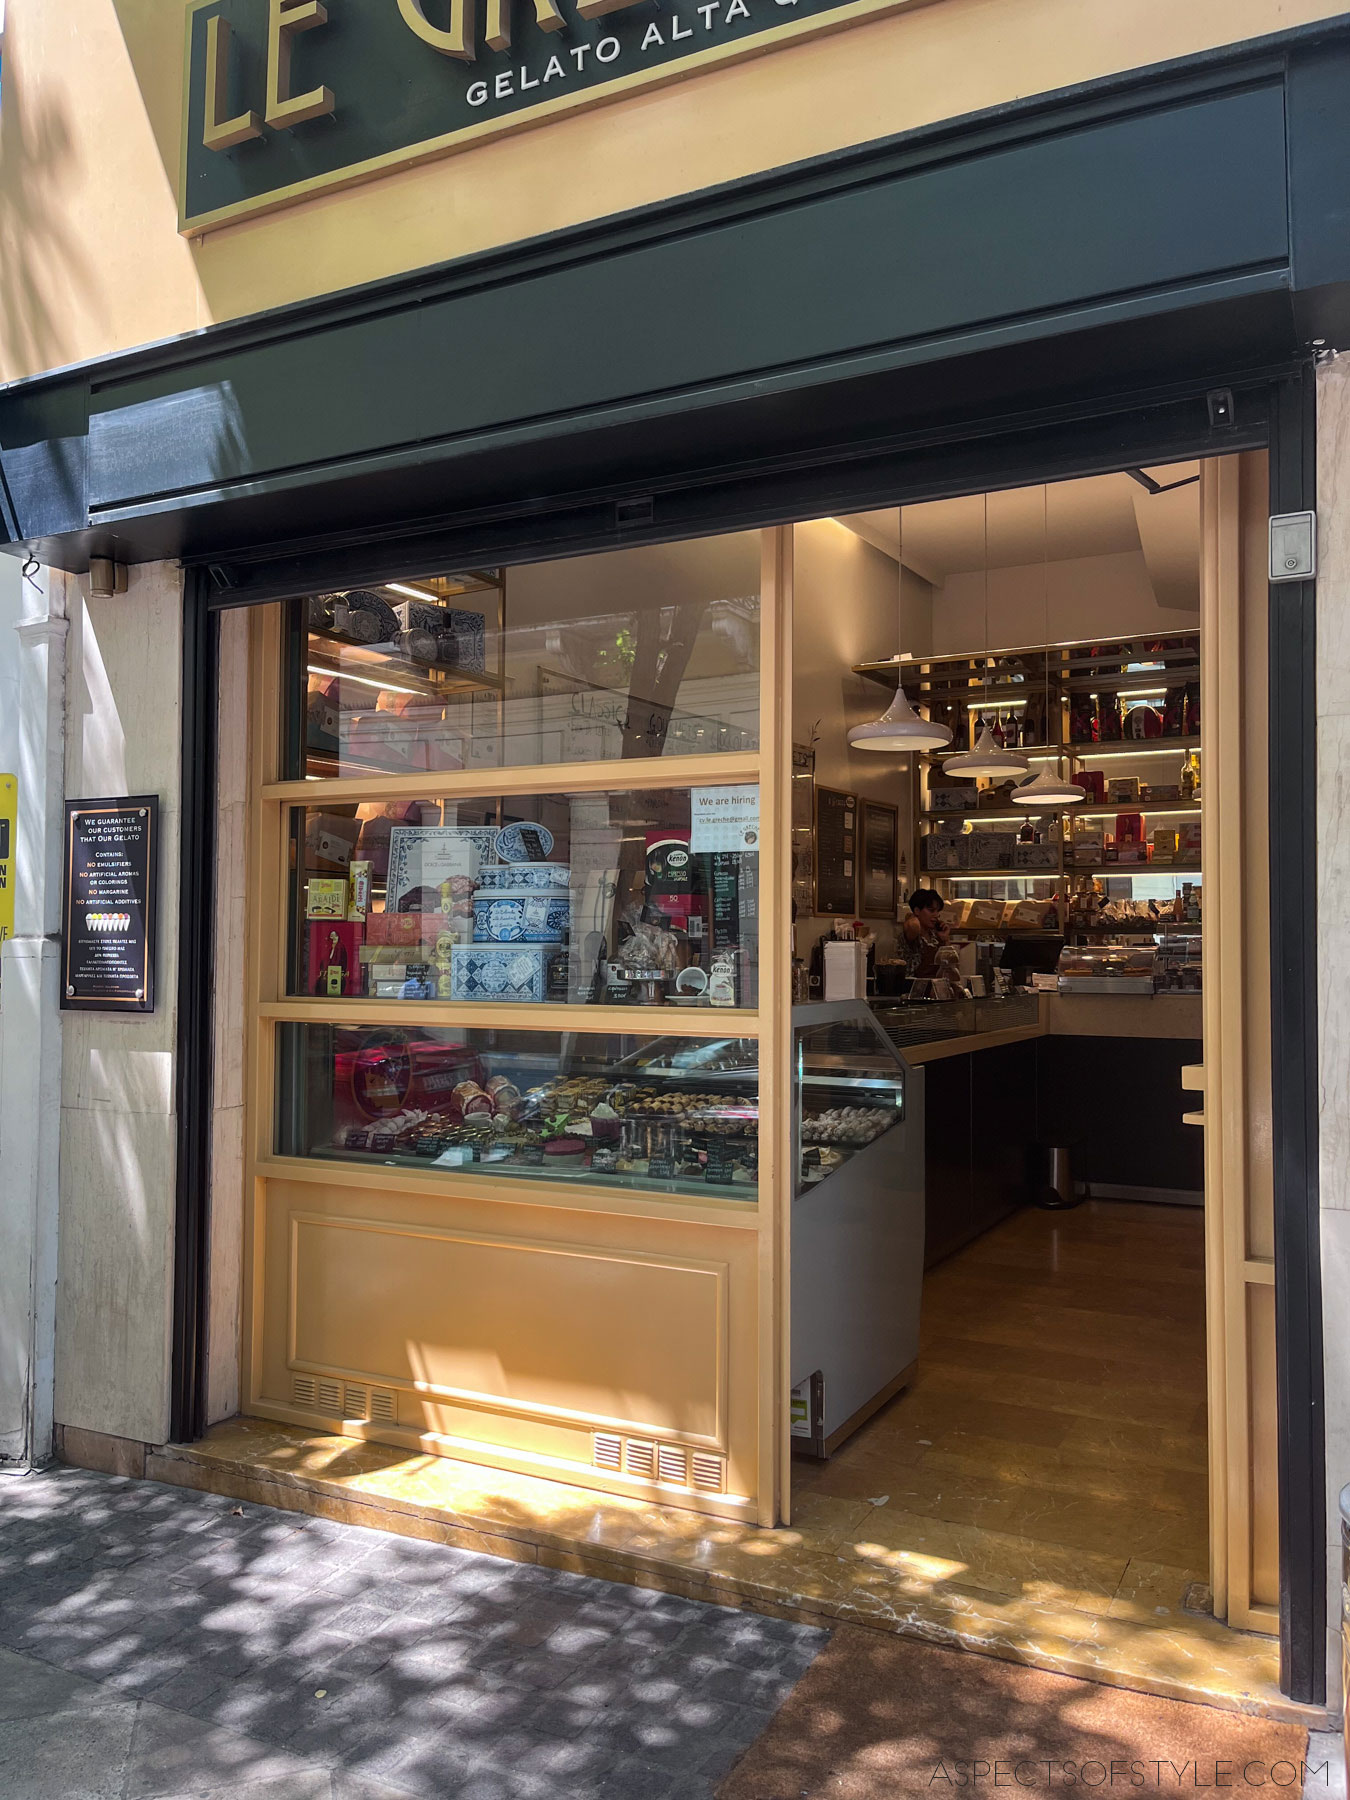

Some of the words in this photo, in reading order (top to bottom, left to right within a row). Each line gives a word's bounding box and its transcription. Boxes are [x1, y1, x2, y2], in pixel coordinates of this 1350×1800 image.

[466, 36, 621, 107] GELATO
[640, 0, 751, 51] ALTA
[203, 0, 334, 151] LE
[699, 797, 713, 806] We
[731, 796, 756, 806] hiring
[97, 817, 136, 825] GUARANTEE
[103, 825, 142, 833] CUSTOMERS
